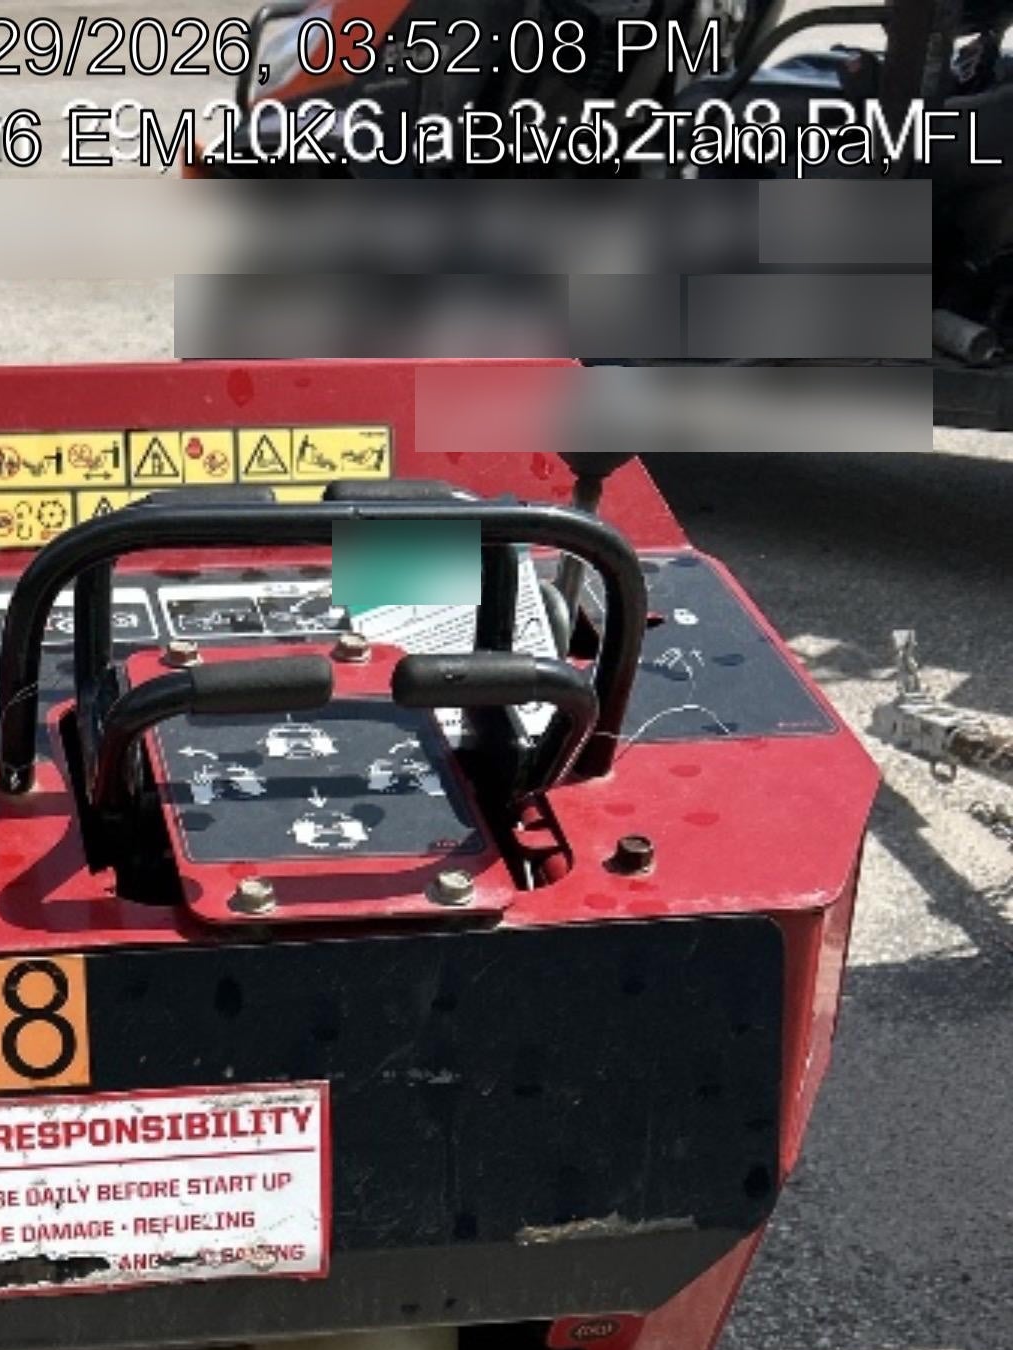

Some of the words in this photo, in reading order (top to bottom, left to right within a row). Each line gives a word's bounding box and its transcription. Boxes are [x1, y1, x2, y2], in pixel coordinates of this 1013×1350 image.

[26, 1184, 90, 1208] DAILY
[97, 1178, 181, 1202] BEFORE
[187, 1174, 257, 1195] START
[262, 1172, 293, 1191] UP
[21, 1220, 115, 1242] DAMAGE
